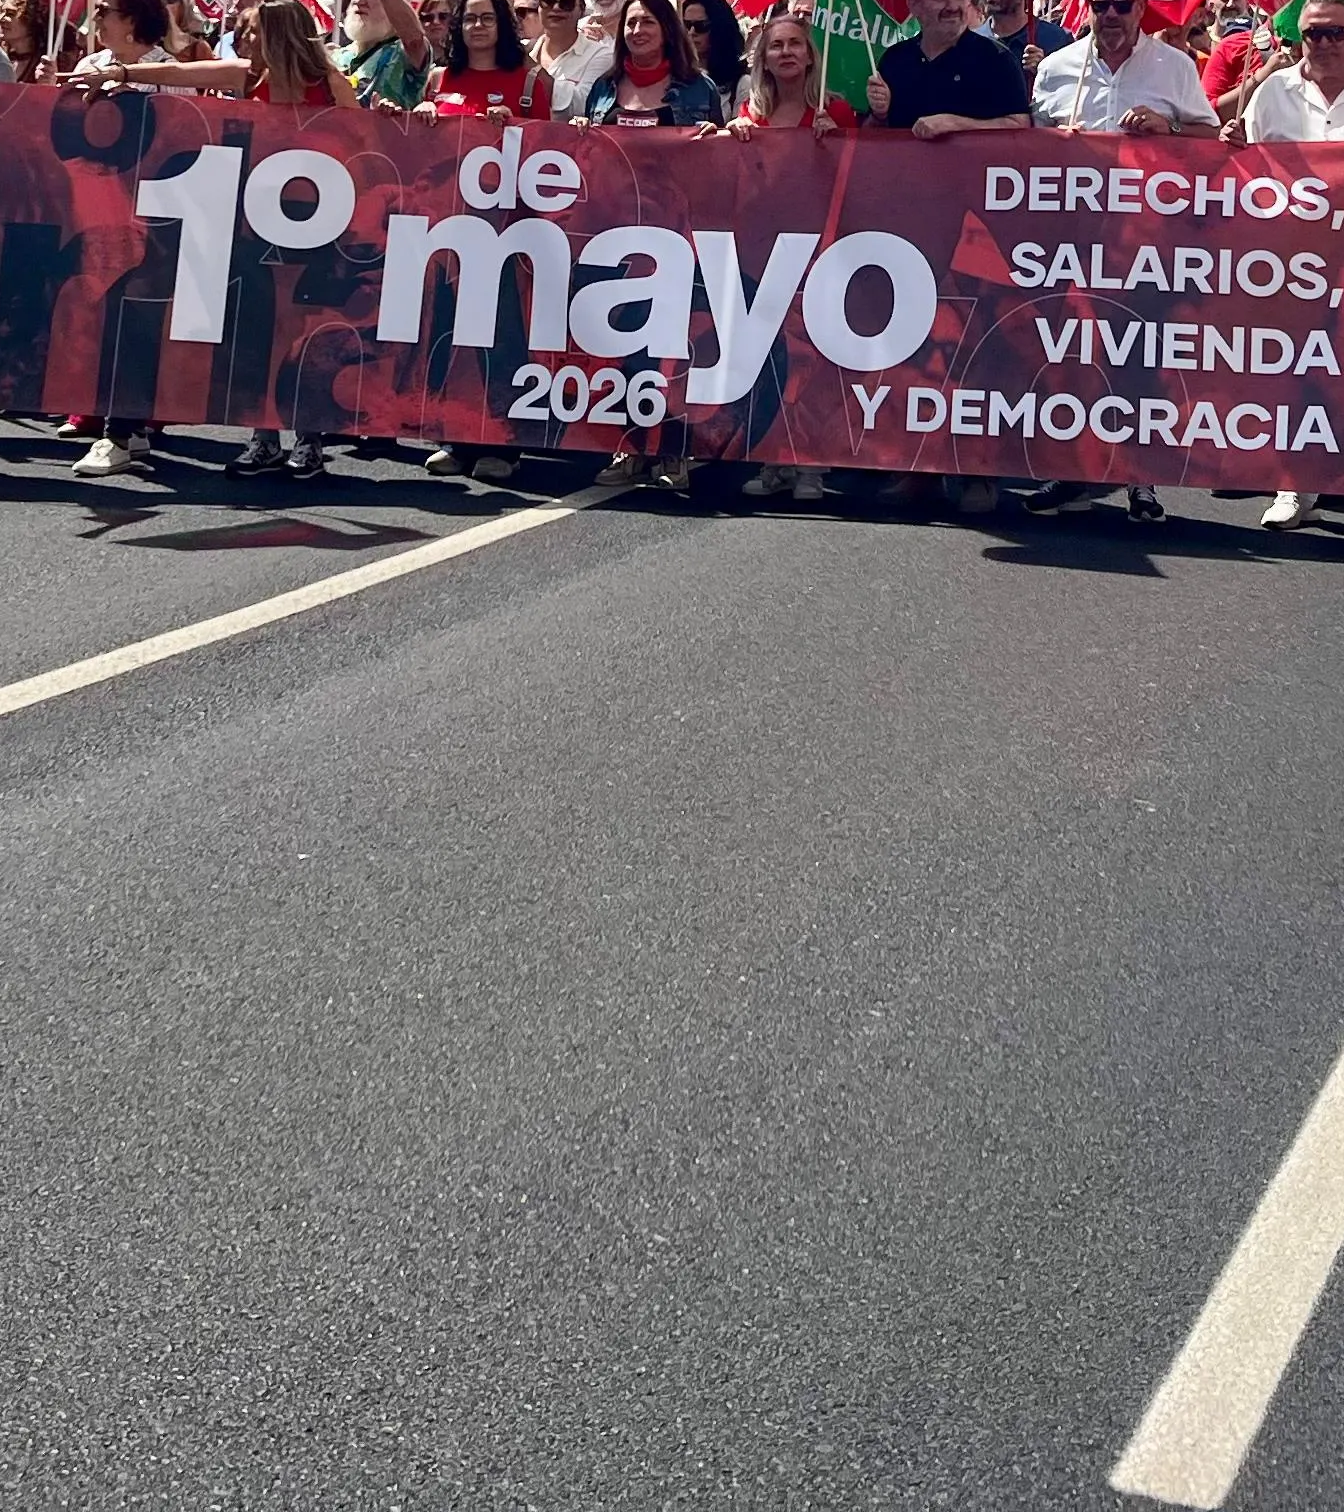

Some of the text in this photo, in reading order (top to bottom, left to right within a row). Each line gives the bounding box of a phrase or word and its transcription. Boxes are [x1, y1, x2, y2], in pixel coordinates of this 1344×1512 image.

[135, 126, 937, 405] 1º de mayo
[1009, 241, 1344, 309] SALARIOS,
[1035, 317, 1342, 376] VIVIENDA
[507, 363, 669, 428] 2026
[851, 384, 1340, 454] Y DEMOCRACIA
